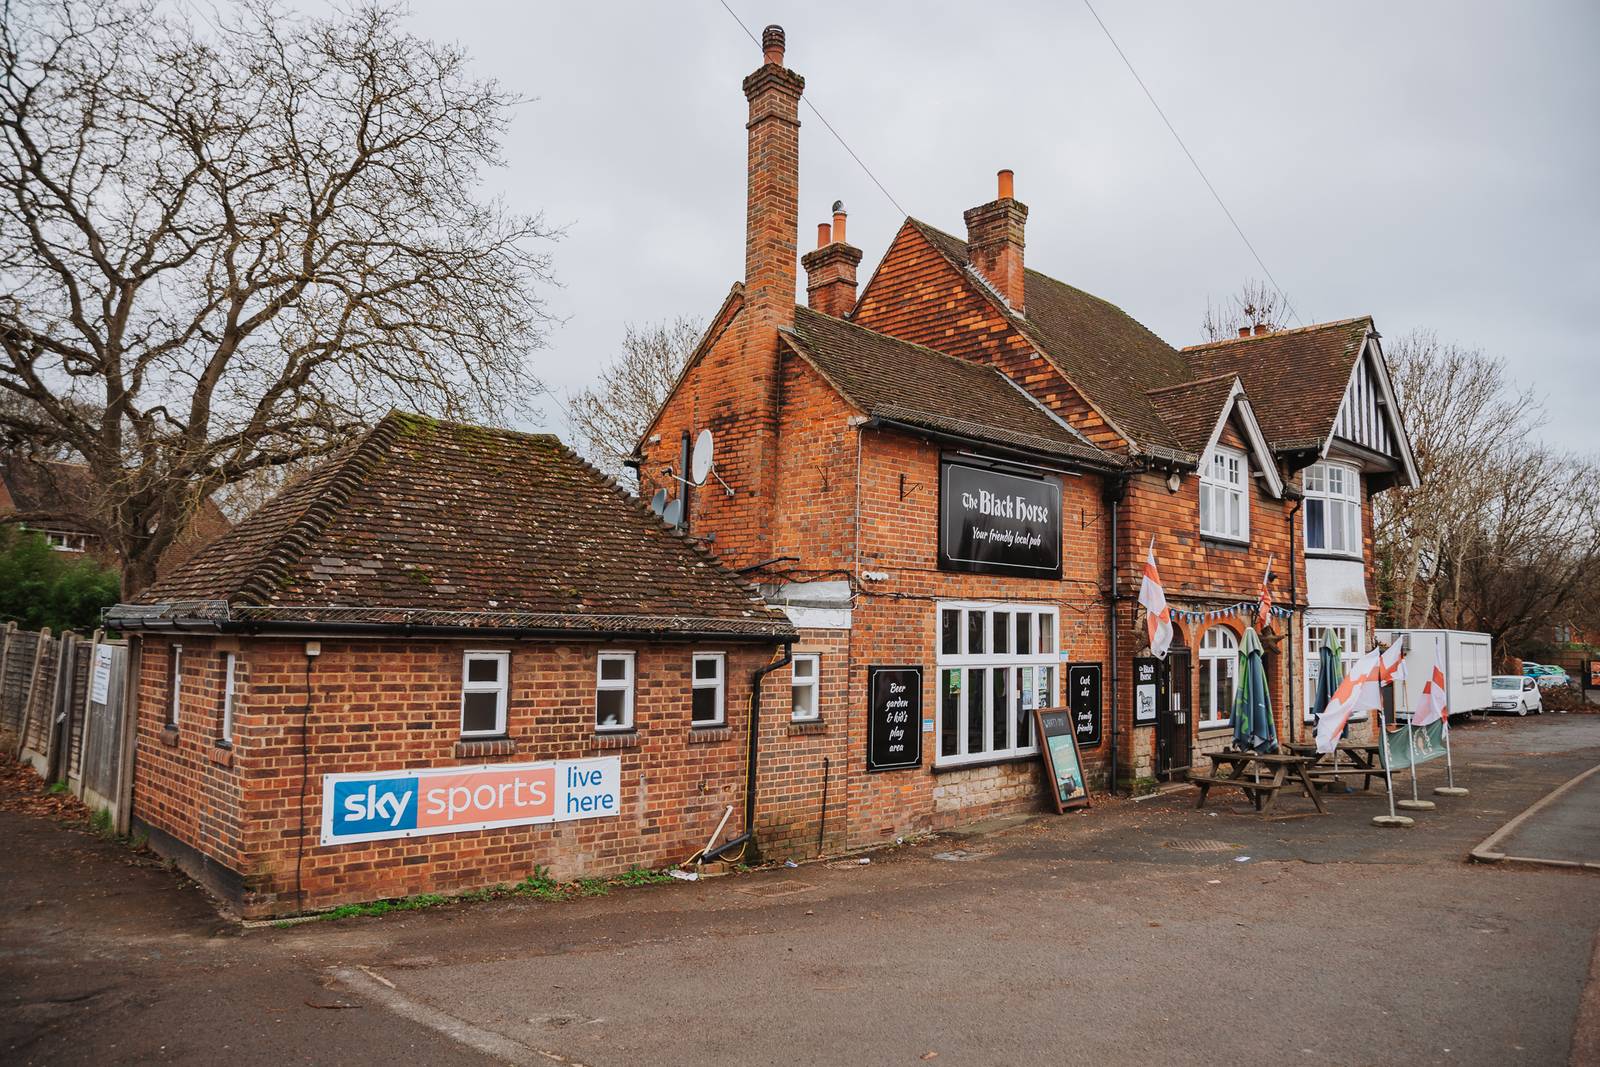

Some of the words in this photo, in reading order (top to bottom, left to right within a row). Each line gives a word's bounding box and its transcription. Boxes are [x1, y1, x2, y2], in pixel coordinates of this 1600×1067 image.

[961, 492, 978, 511] The
[978, 488, 1014, 518] Black
[1015, 496, 1049, 524] Horse
[972, 526, 988, 540] Your
[988, 529, 1014, 548] friendly
[1014, 530, 1029, 546] local
[1028, 534, 1042, 550] pub
[890, 682, 906, 694] Beer
[1079, 675, 1091, 686] Cask
[885, 697, 909, 712] garden
[886, 714, 894, 723] &
[1077, 710, 1093, 723] Family
[888, 726, 905, 741] play
[1076, 722, 1094, 735] friendly
[889, 744, 904, 752] area
[567, 766, 603, 787] live
[343, 784, 413, 827] sky
[426, 776, 547, 821] sports
[567, 789, 614, 814] here
